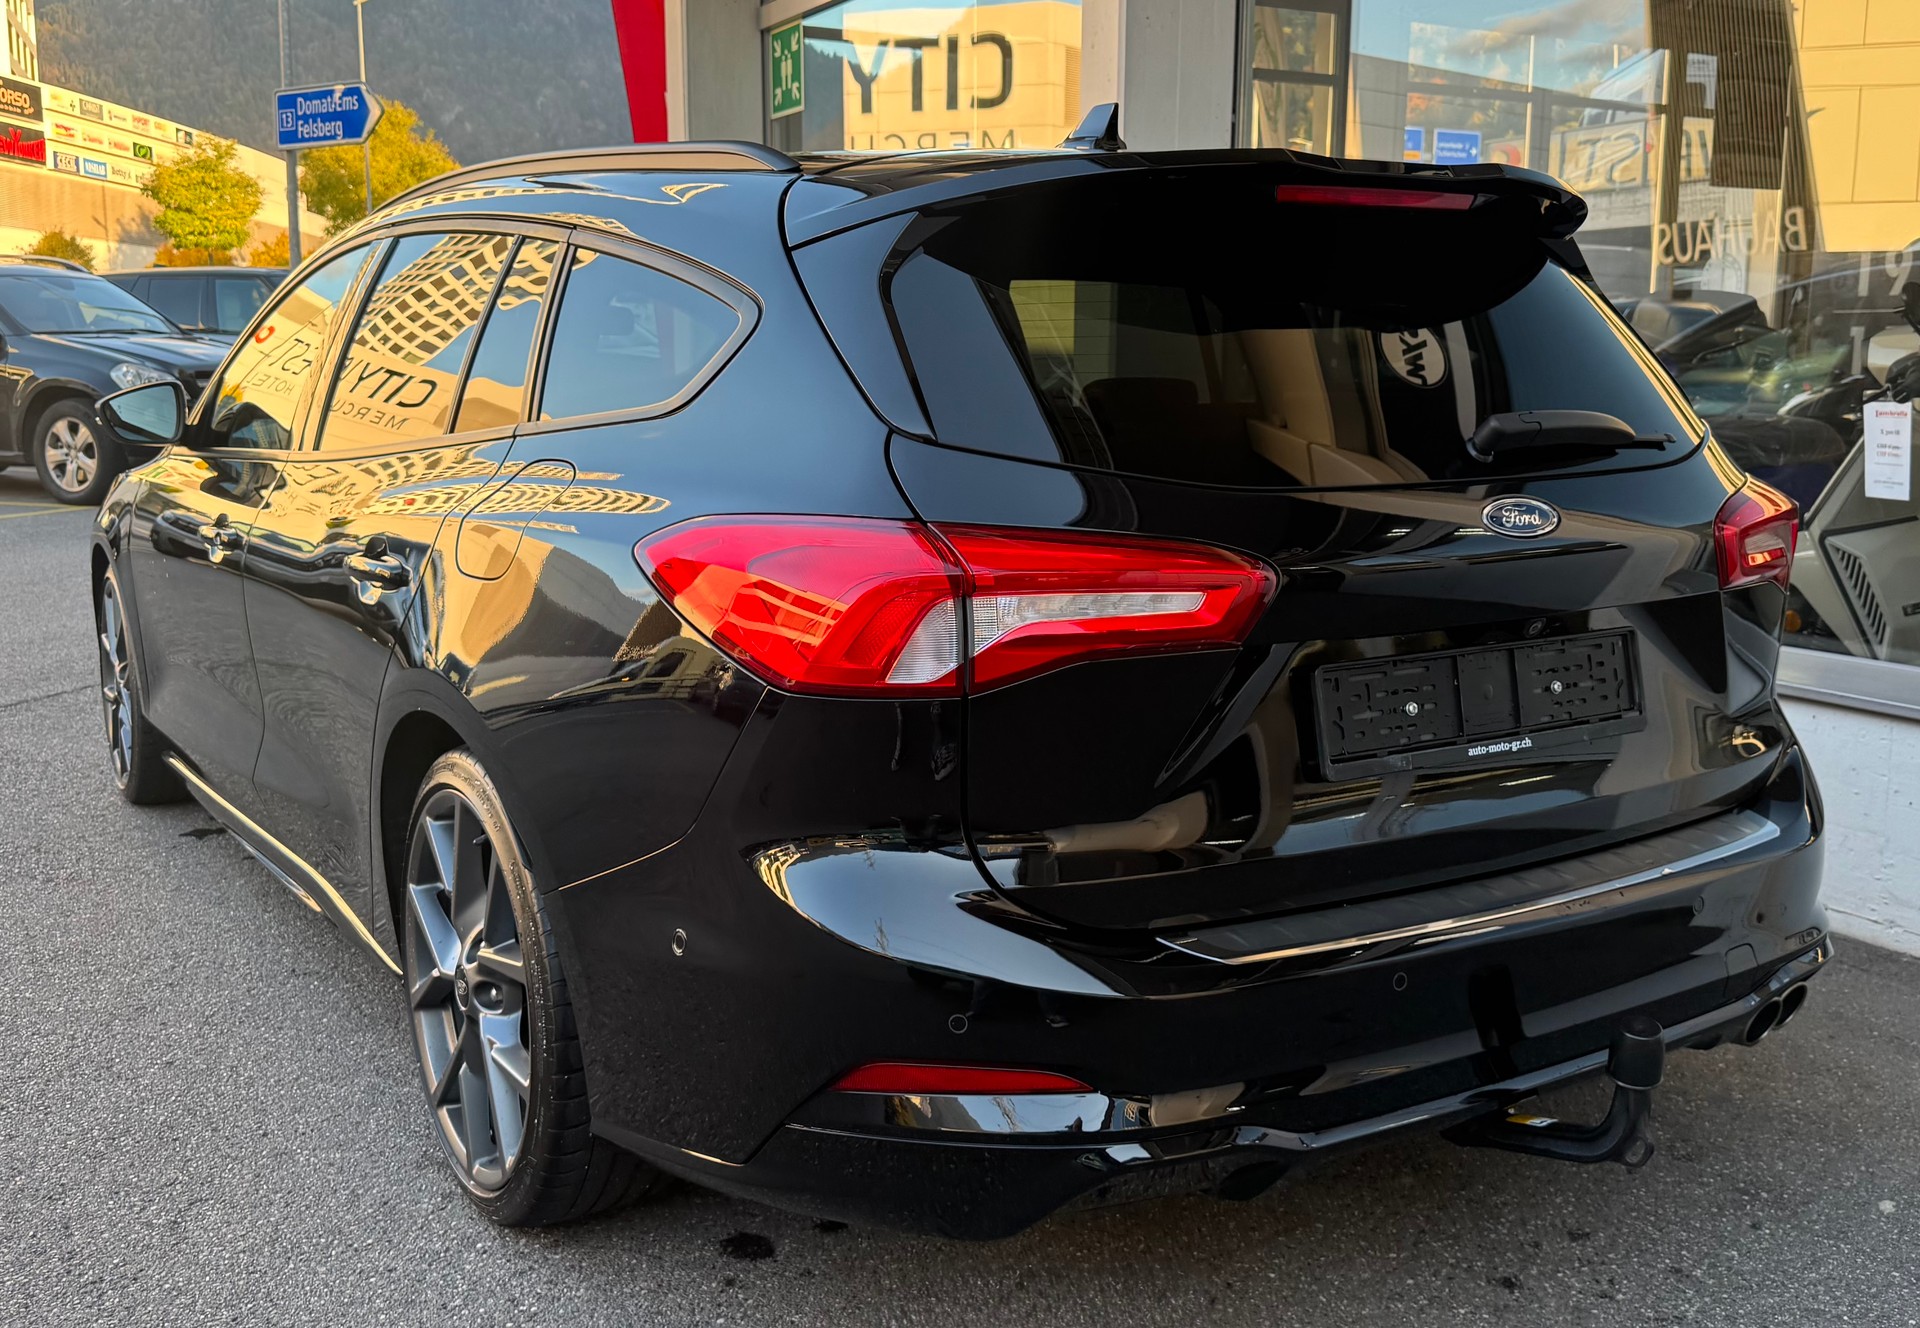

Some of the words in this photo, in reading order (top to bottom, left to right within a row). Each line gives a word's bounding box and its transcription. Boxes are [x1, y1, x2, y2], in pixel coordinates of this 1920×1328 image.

[296, 95, 359, 115] Domat/Ems
[281, 112, 293, 128] 13
[297, 117, 343, 139] Felsberg
[1502, 505, 1542, 528] Ford
[1467, 737, 1532, 757] auto-moto-gr.ch
